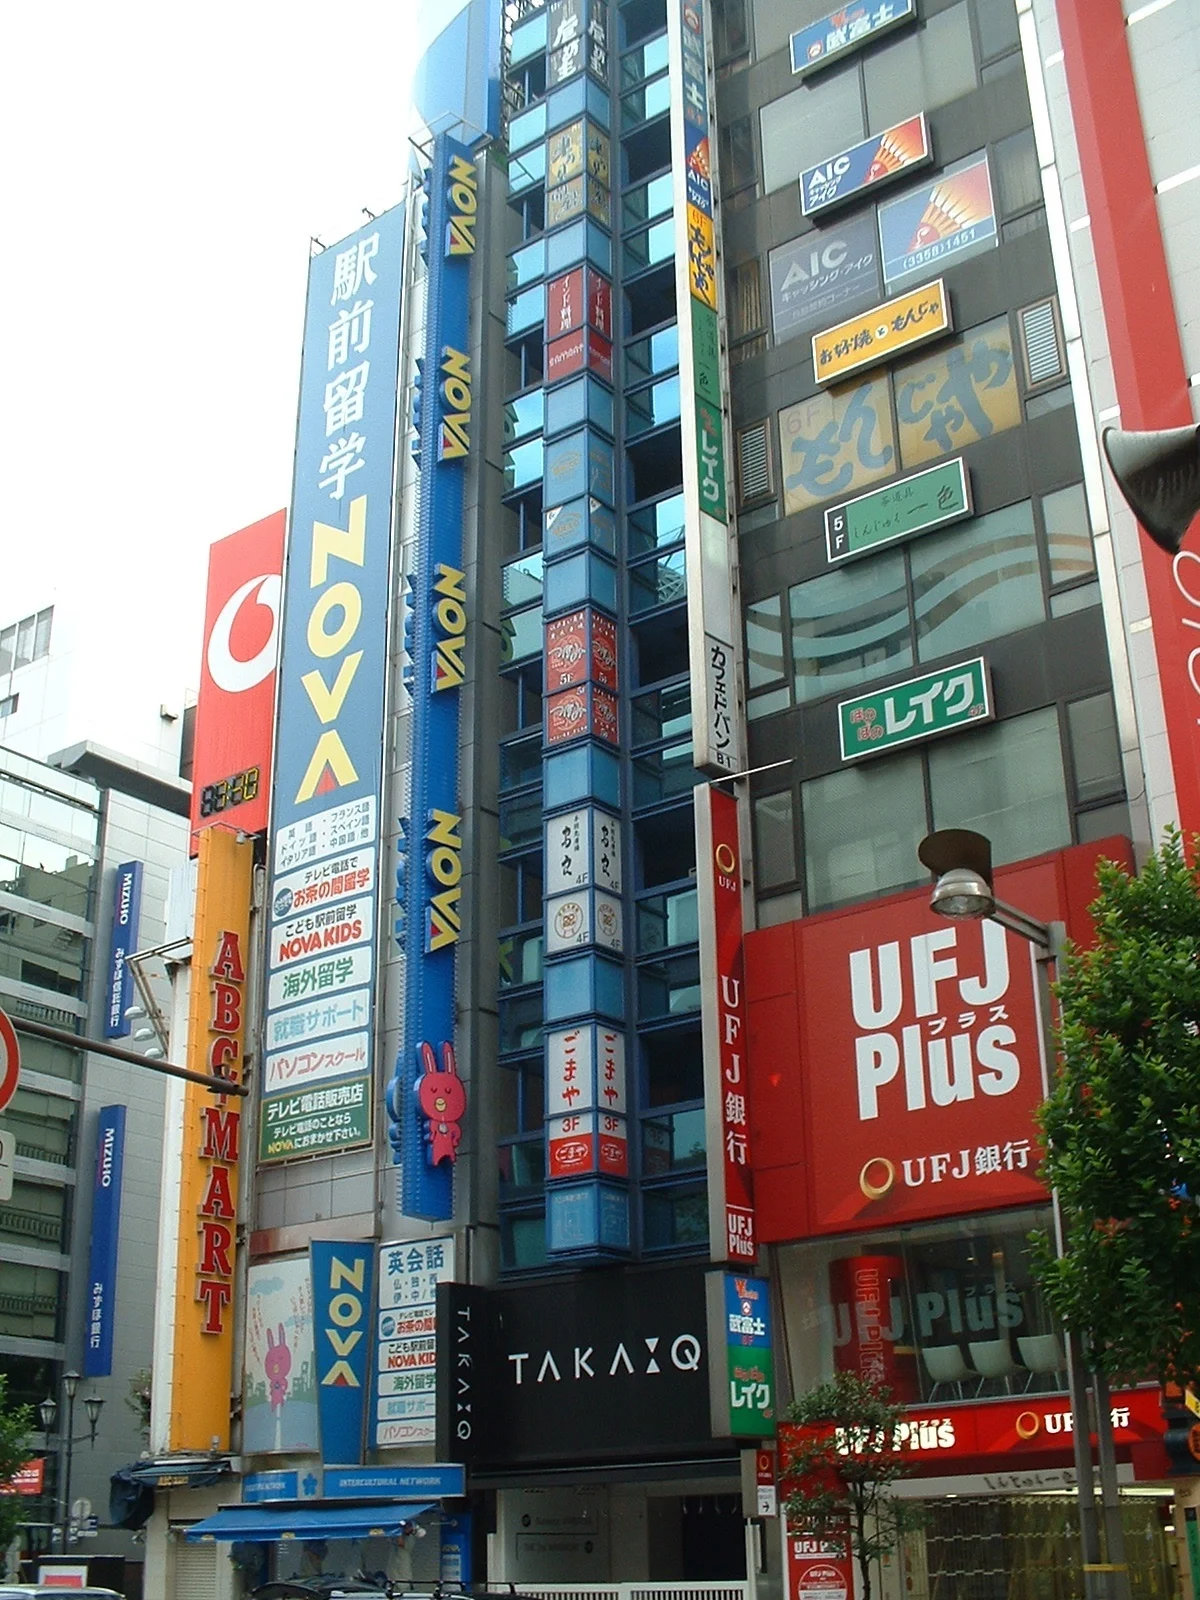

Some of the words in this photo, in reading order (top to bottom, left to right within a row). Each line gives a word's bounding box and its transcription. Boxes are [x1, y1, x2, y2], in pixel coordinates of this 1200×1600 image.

[687, 169, 709, 192] AIC
[808, 155, 850, 189] AIC
[446, 154, 478, 257] NOVA
[809, 184, 838, 207] アイク
[780, 240, 848, 292] AIC
[318, 232, 379, 500] 駅前留学
[439, 345, 472, 461] NOVA
[701, 428, 719, 502] レイク
[431, 562, 466, 694] NOVA
[295, 494, 369, 806] NOVA
[884, 672, 975, 735] レイク
[716, 752, 732, 769] B1
[293, 867, 370, 908] お茶の間留学
[304, 856, 359, 884] テレビ電話で
[425, 807, 462, 954] NOVA
[718, 875, 736, 893] UFJ
[120, 873, 133, 926] MIZUHO
[285, 903, 357, 938] こども駅前留学
[279, 930, 322, 963] NOVA
[323, 919, 362, 946] KIDS
[283, 956, 354, 1000] 海外留学
[849, 917, 1011, 1030] UFJ
[273, 999, 364, 1043] 就職サポート
[928, 1004, 1009, 1036] プラス
[269, 1048, 366, 1082] パソコンスクール
[561, 1029, 581, 1107] ごまや
[603, 1032, 619, 1107] ごまや
[720, 974, 747, 1167] UFJ銀行
[854, 1023, 1021, 1121] Plus
[266, 1083, 364, 1122] テレビ電話販売店
[604, 1115, 619, 1132] 3F
[273, 1112, 352, 1139] テレビ電話のことなら
[562, 1116, 580, 1133] 3F
[101, 1127, 115, 1187] MIZUHO
[902, 1138, 1031, 1187] UFJ銀行
[727, 1211, 753, 1238] UFJ
[728, 1233, 754, 1257] Plus
[387, 1244, 444, 1277] 英会話
[321, 1256, 366, 1387] NOVA
[397, 1316, 437, 1335] お茶の間
[728, 1313, 766, 1336] 武富士
[916, 1286, 1024, 1338] Plus
[730, 1381, 771, 1409] レイク
[893, 1419, 955, 1451] Plus
[794, 1541, 817, 1553] UFJ
